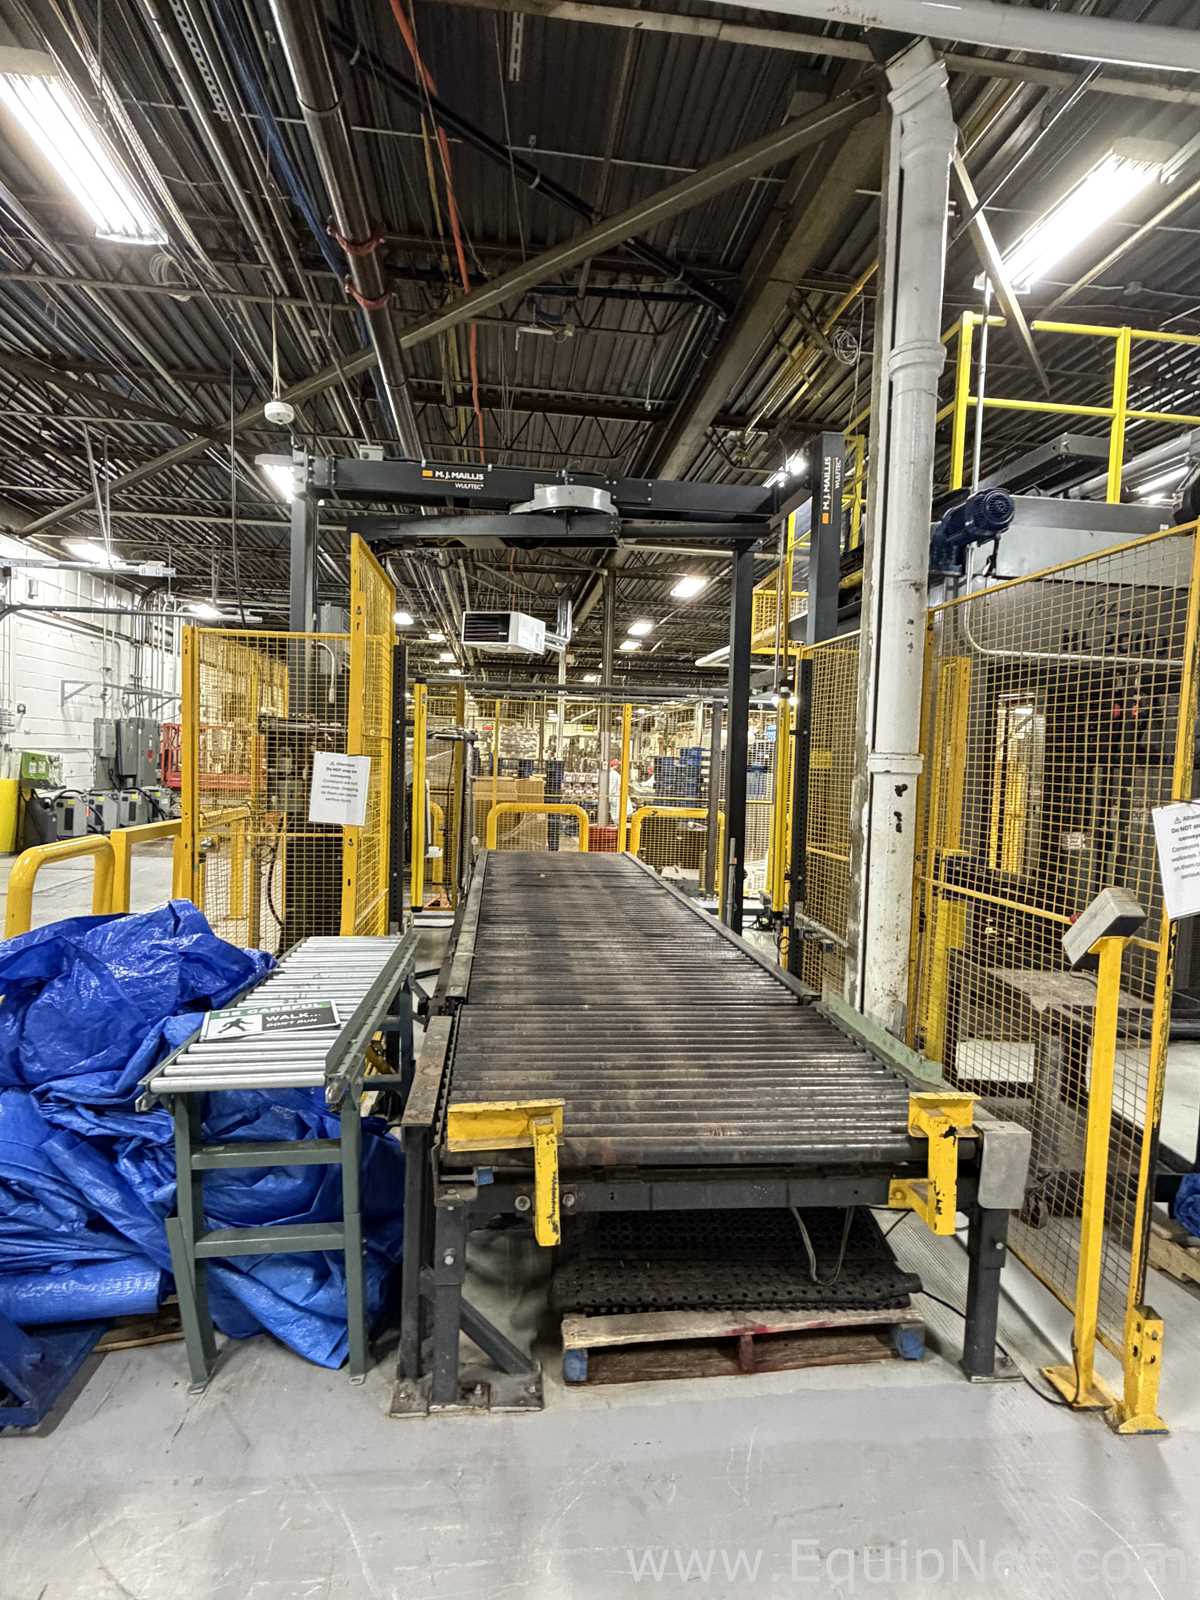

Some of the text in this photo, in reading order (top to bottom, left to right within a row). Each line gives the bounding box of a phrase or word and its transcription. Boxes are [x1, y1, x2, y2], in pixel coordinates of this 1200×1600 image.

[451, 471, 485, 481] MAILLIS
[823, 455, 831, 492] MAILLIS
[1180, 824, 1192, 832] NOT
[247, 1003, 321, 1014] CAREFUL
